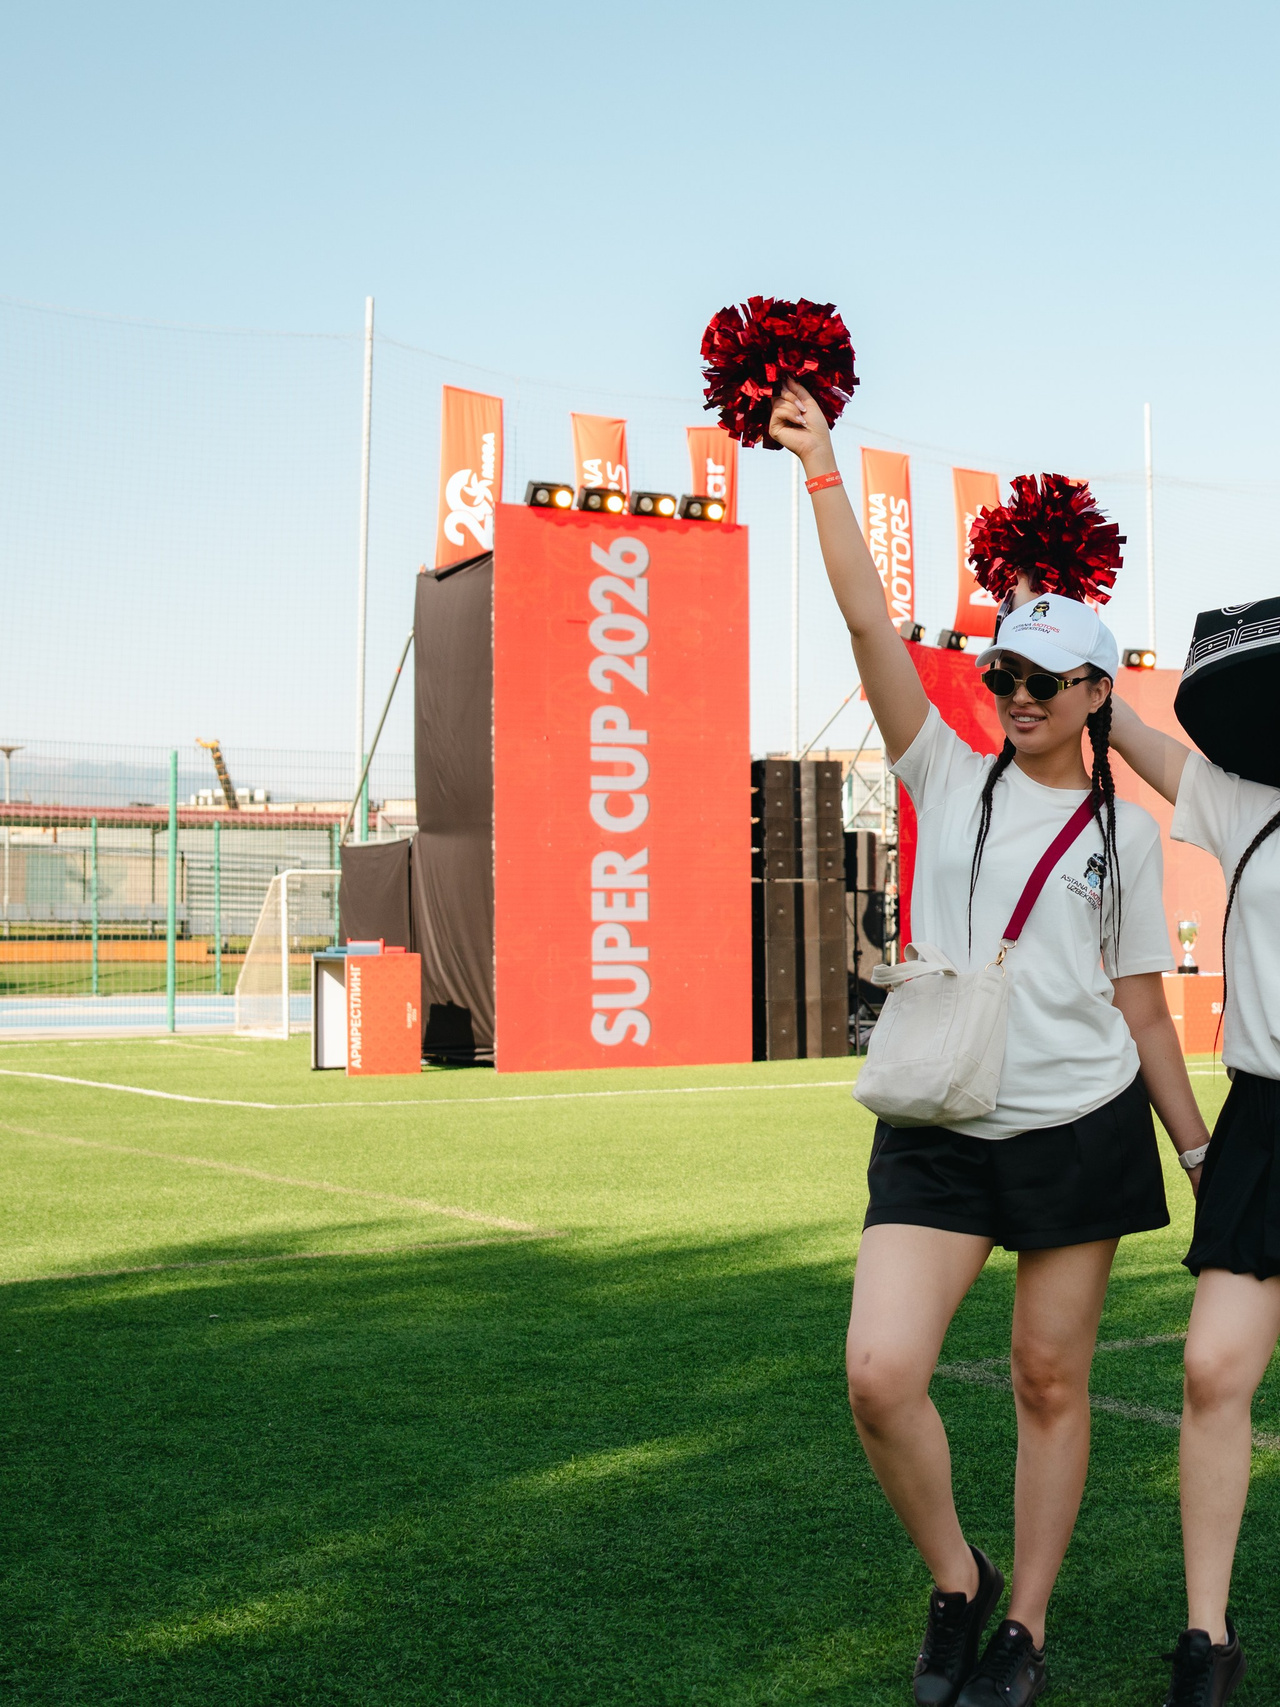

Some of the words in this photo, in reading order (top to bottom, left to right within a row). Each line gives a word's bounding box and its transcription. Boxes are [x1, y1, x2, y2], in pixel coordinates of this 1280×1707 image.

[588, 535, 650, 696] 2026
[889, 496, 912, 628] MOTORS
[1032, 623, 1060, 633] MOTORS
[588, 704, 650, 834] CUP
[590, 846, 651, 1047] SUPER
[1060, 874, 1088, 892] ASTANA
[1089, 890, 1102, 910] MOTO
[1066, 883, 1098, 910] UZBEKISTAN
[350, 964, 362, 1068] АРМРЕСТЛИНГ
